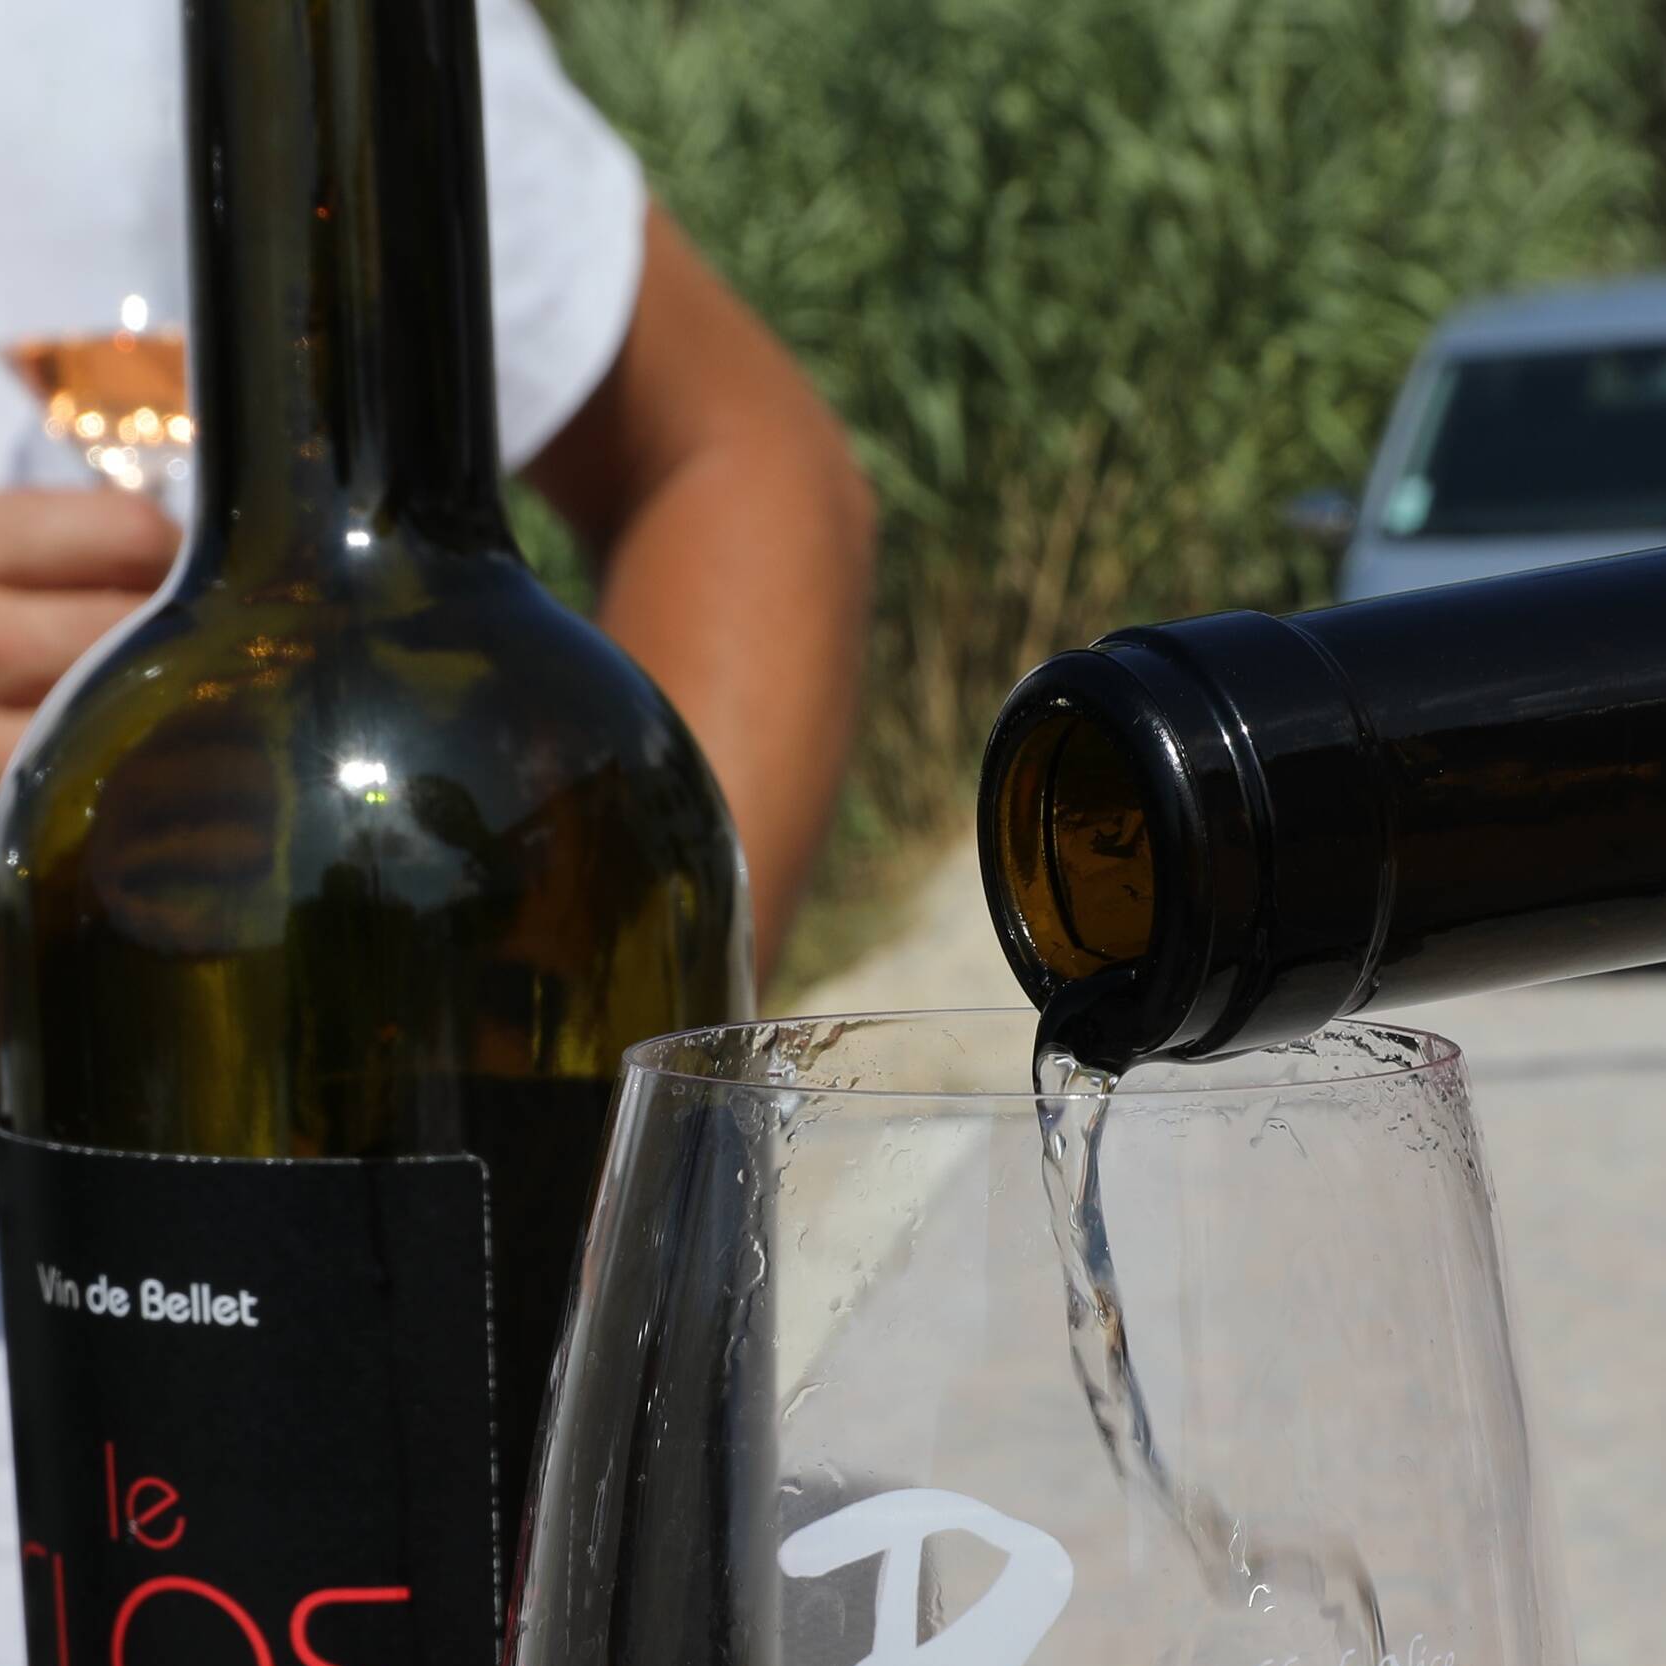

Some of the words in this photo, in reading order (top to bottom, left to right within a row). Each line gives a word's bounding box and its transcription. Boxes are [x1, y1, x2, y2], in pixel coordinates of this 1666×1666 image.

[36, 1262, 80, 1310] Vin
[85, 1273, 131, 1318] de
[139, 1277, 259, 1328] Bellet
[104, 1440, 187, 1550] le
